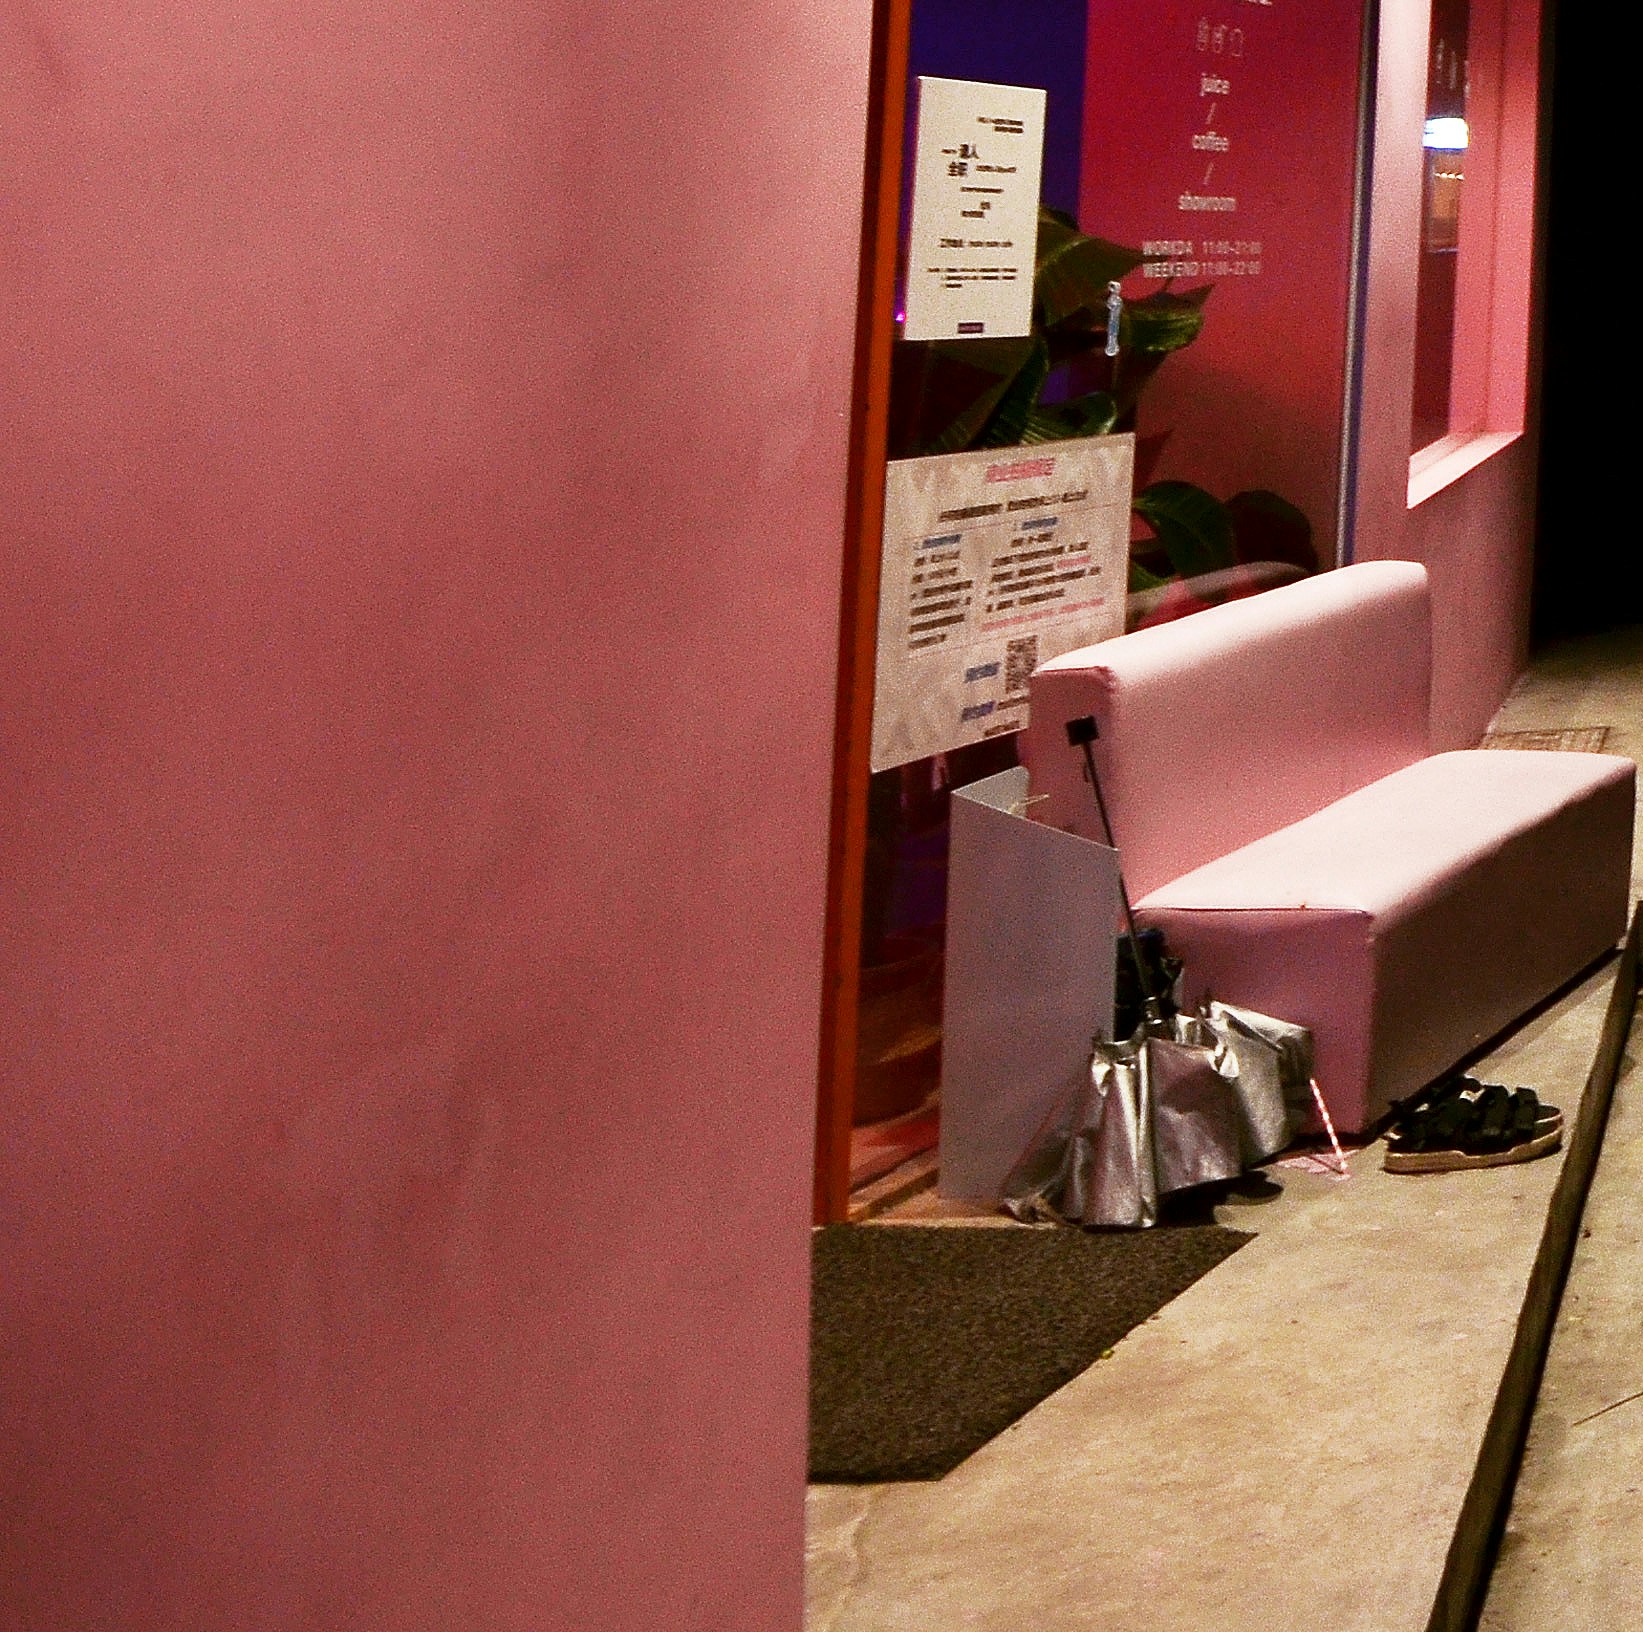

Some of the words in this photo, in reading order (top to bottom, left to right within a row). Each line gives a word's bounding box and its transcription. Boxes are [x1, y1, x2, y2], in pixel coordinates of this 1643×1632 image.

[1200, 72, 1231, 97] juice
[1192, 131, 1229, 152] coffee
[1178, 191, 1237, 212] showroom
[1142, 262, 1200, 278] WEEKEND
